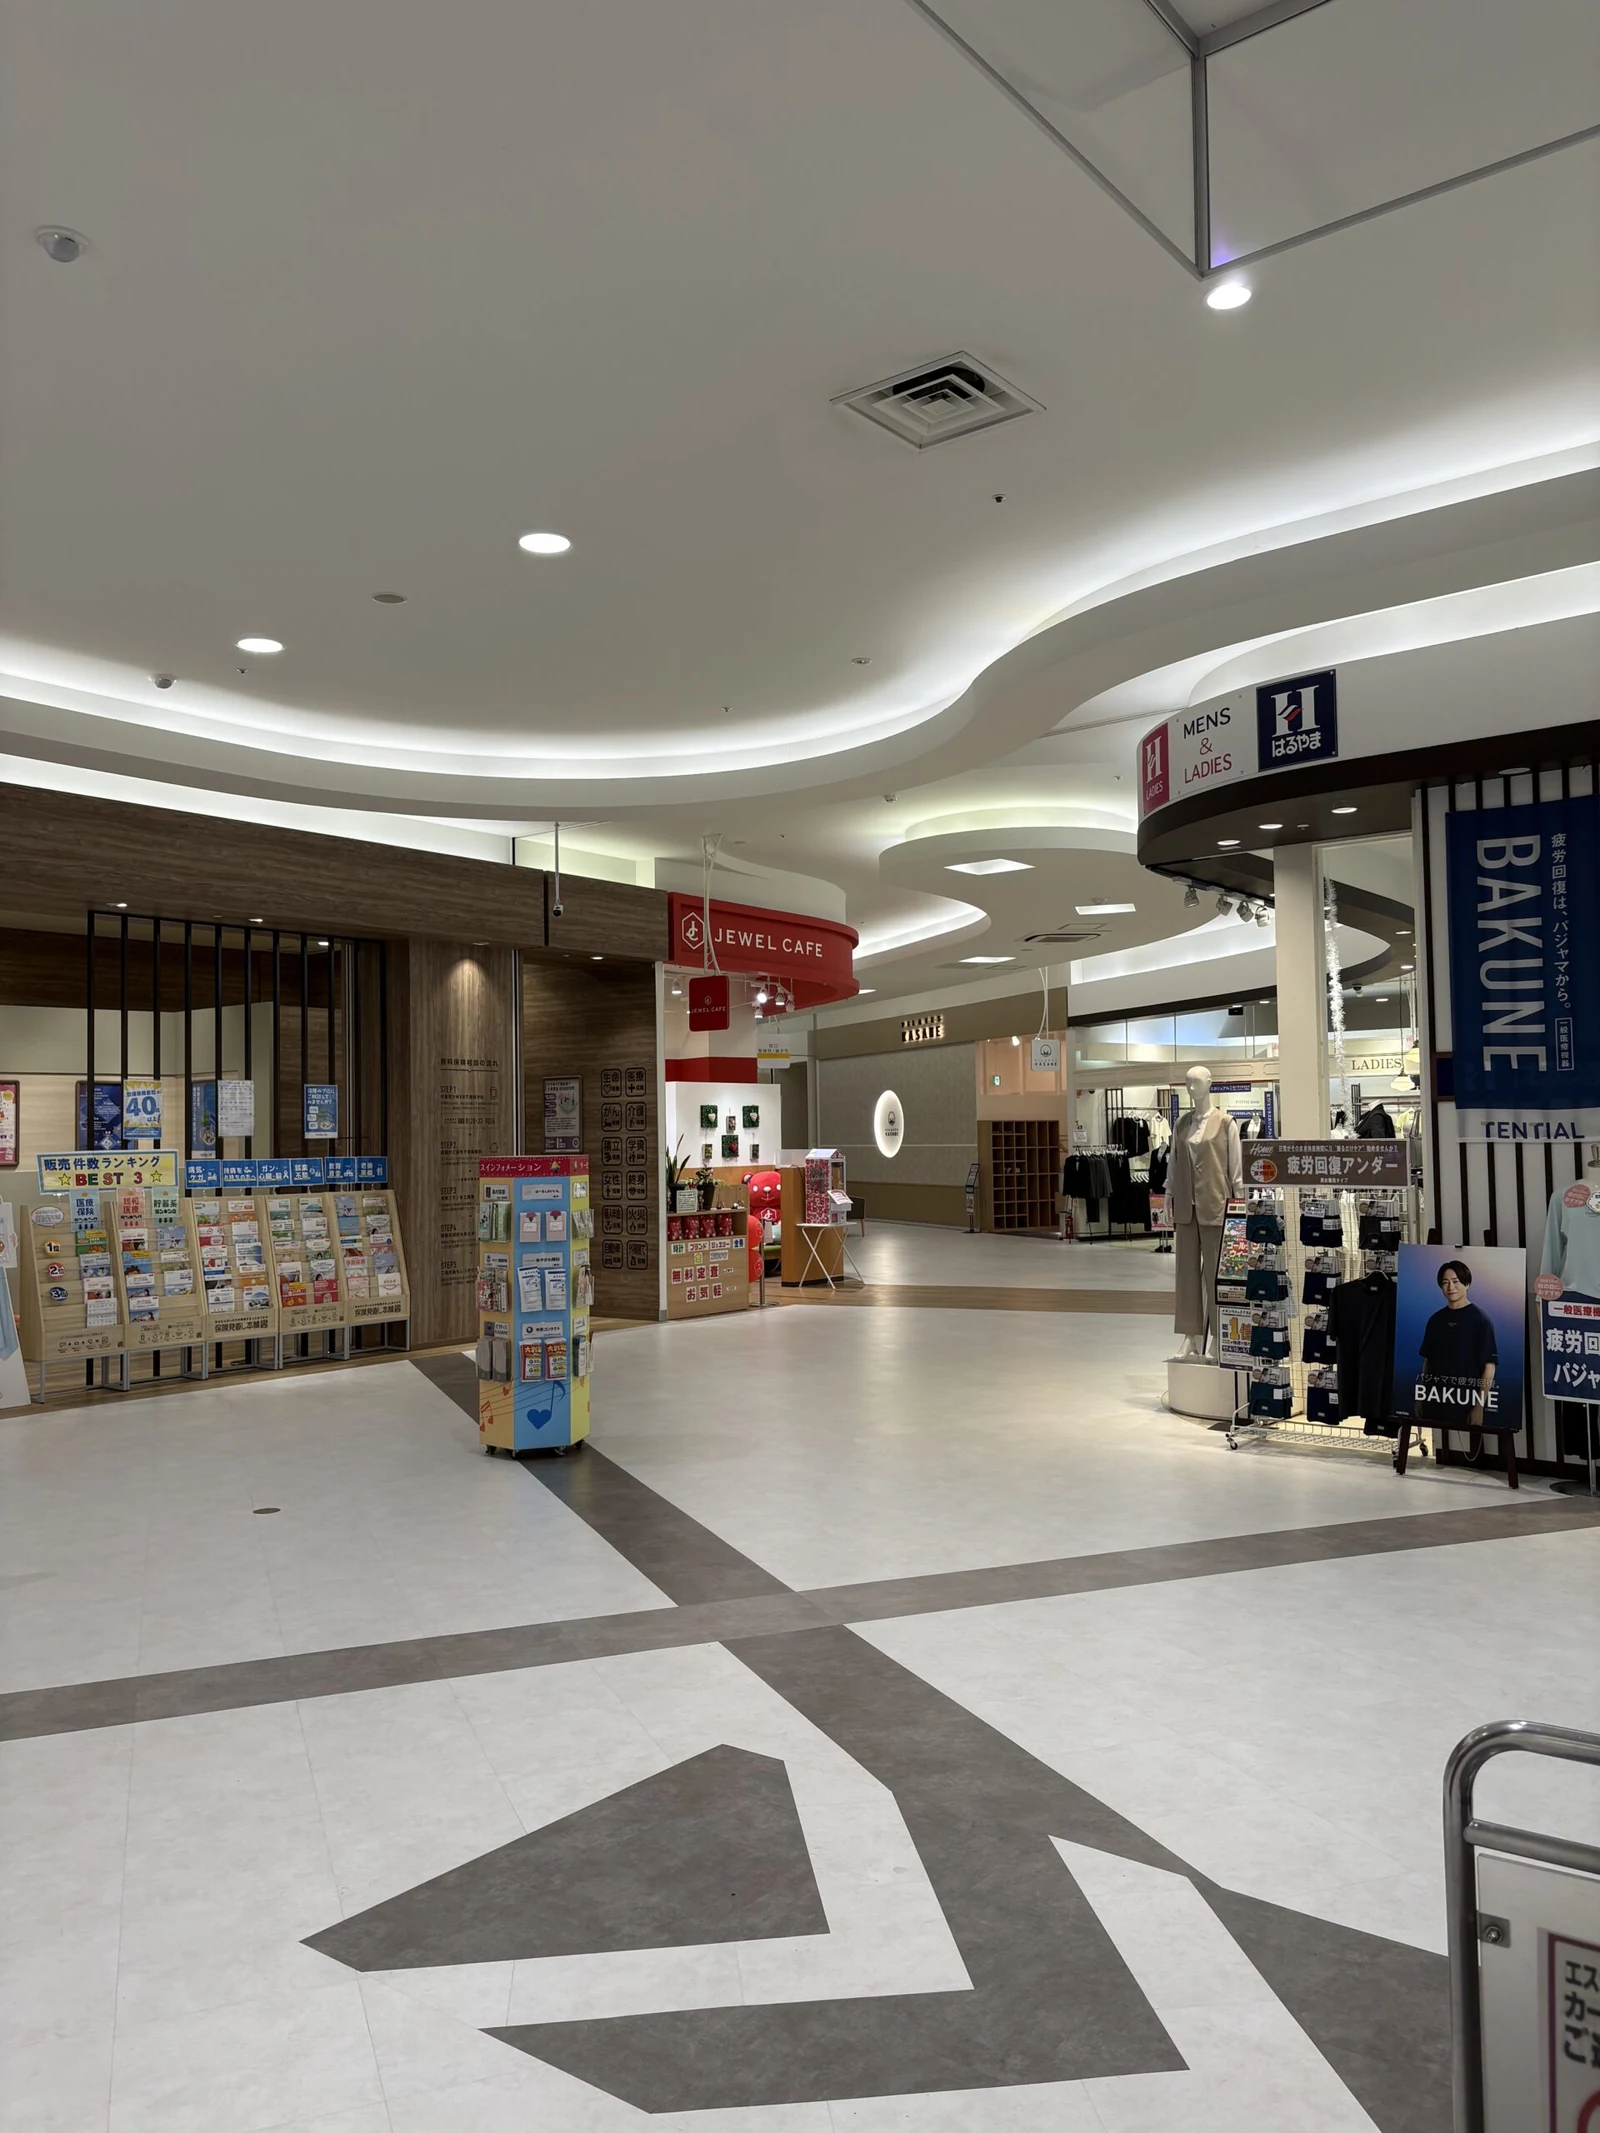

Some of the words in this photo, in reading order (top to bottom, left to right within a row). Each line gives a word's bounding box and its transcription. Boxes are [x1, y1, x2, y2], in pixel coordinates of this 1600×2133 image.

[1183, 707, 1232, 739] MENS
[1199, 737, 1213, 755] &
[1271, 731, 1322, 757] はるやま
[1184, 753, 1233, 784] LADIES
[1145, 780, 1164, 801] LADIES
[1551, 832, 1571, 1009] 疲労回復は、パジャマから。
[714, 928, 777, 950] JEWEL
[782, 938, 823, 958] CAFE
[1477, 834, 1547, 1072] BAKUNE
[690, 1006, 711, 1014] JEWEL
[710, 1005, 727, 1013] CAFE
[901, 1025, 941, 1043] KASANE
[1352, 1058, 1402, 1070] LADIES
[603, 1072, 620, 1083] 生命
[628, 1071, 644, 1082] 医療
[604, 1106, 620, 1117] がん
[628, 1105, 644, 1117] 介護
[1481, 1121, 1585, 1140] TENTIAL
[604, 1140, 620, 1151] 積立
[628, 1140, 645, 1151] 学資
[44, 1156, 160, 1171] 販売件数ランキング
[480, 1163, 541, 1172] スインフォメーション
[1287, 1155, 1398, 1175] 疲労回復アンダー
[75, 1172, 123, 1186] BEST
[133, 1171, 143, 1184] 3
[604, 1174, 620, 1185] 女性
[628, 1174, 645, 1186] 終身
[76, 1198, 94, 1207] 医療
[77, 1207, 94, 1216] 保険
[123, 1205, 139, 1214] 医療
[628, 1208, 645, 1220] 火災
[47, 1243, 60, 1252] 1位
[690, 1243, 708, 1251] ブランド
[687, 1284, 722, 1300] お気軽
[1546, 1328, 1600, 1355] 疲労回
[1415, 1385, 1499, 1408] BAKUNE
[1565, 1961, 1600, 1992] エス
